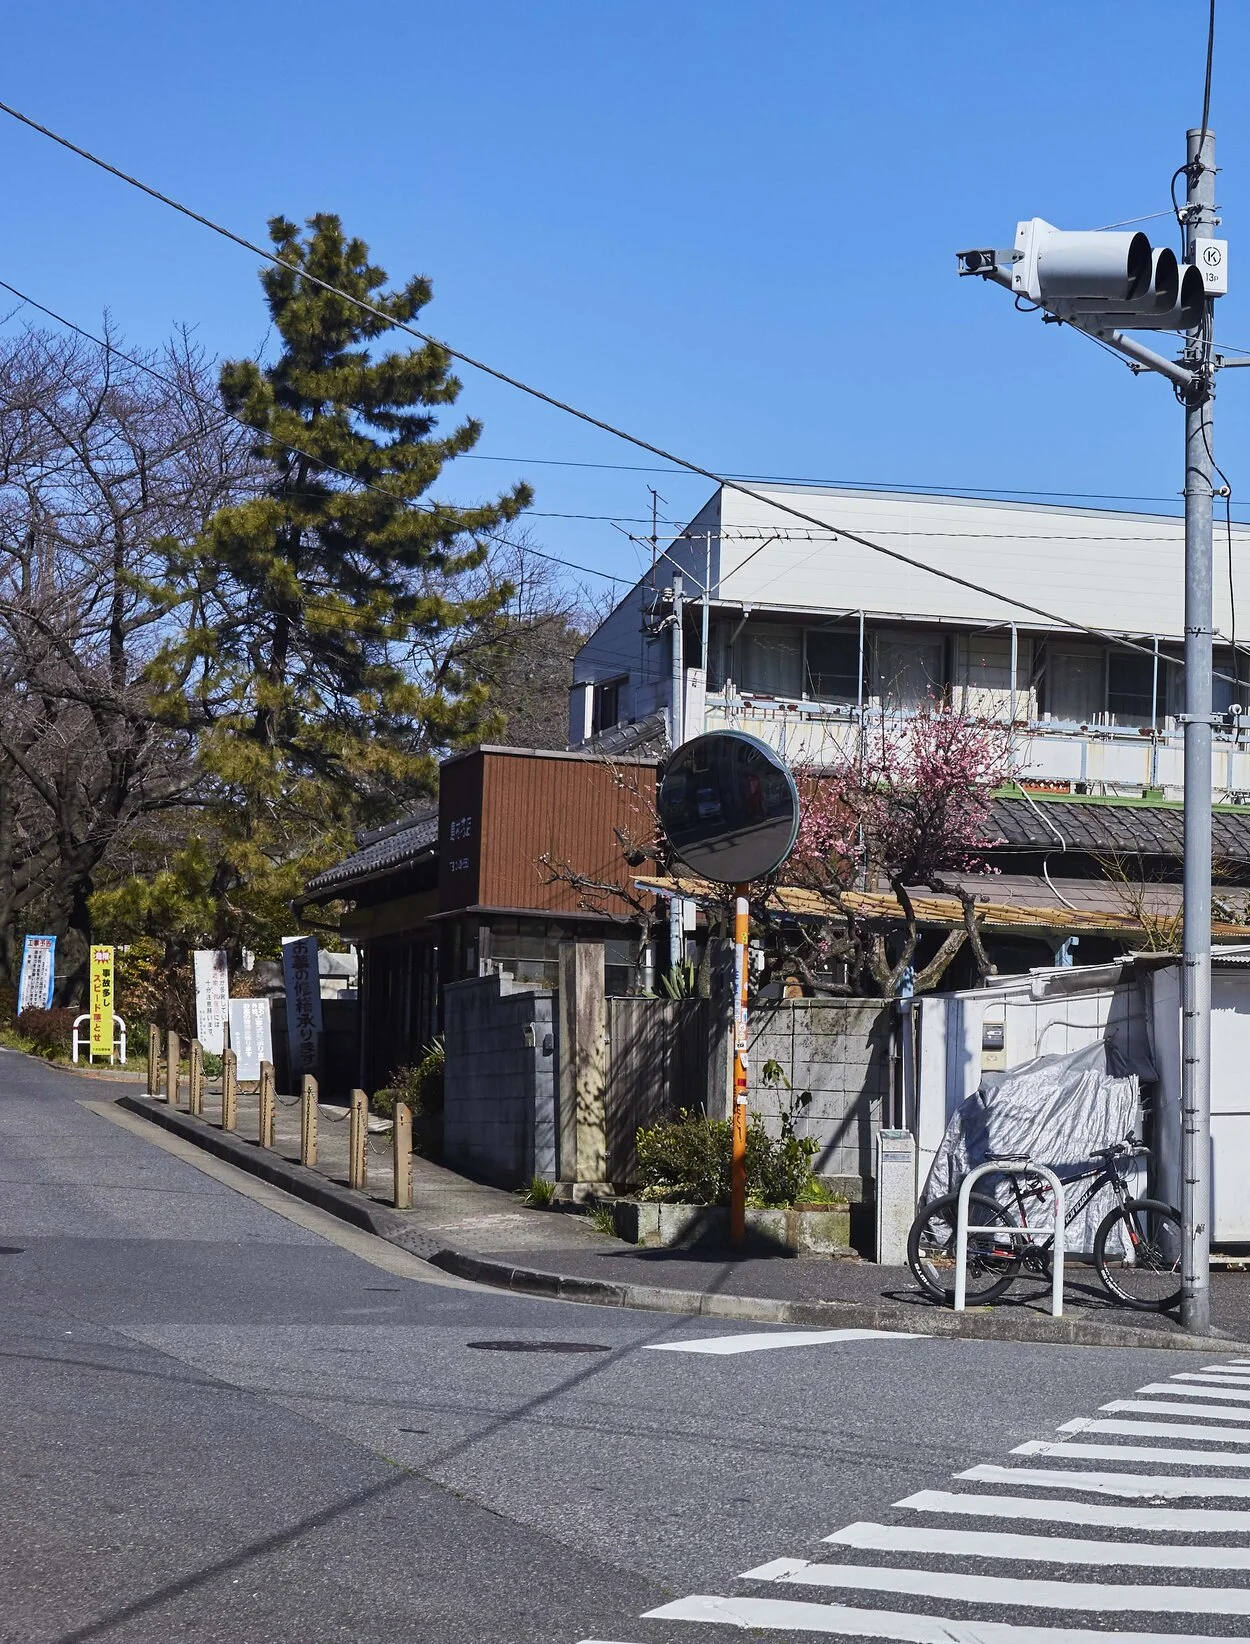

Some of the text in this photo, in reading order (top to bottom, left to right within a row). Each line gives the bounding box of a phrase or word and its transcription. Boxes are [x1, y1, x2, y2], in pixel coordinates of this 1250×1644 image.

[92, 974, 102, 1042] スピード落とせ
[102, 968, 111, 1007] 事故多し
